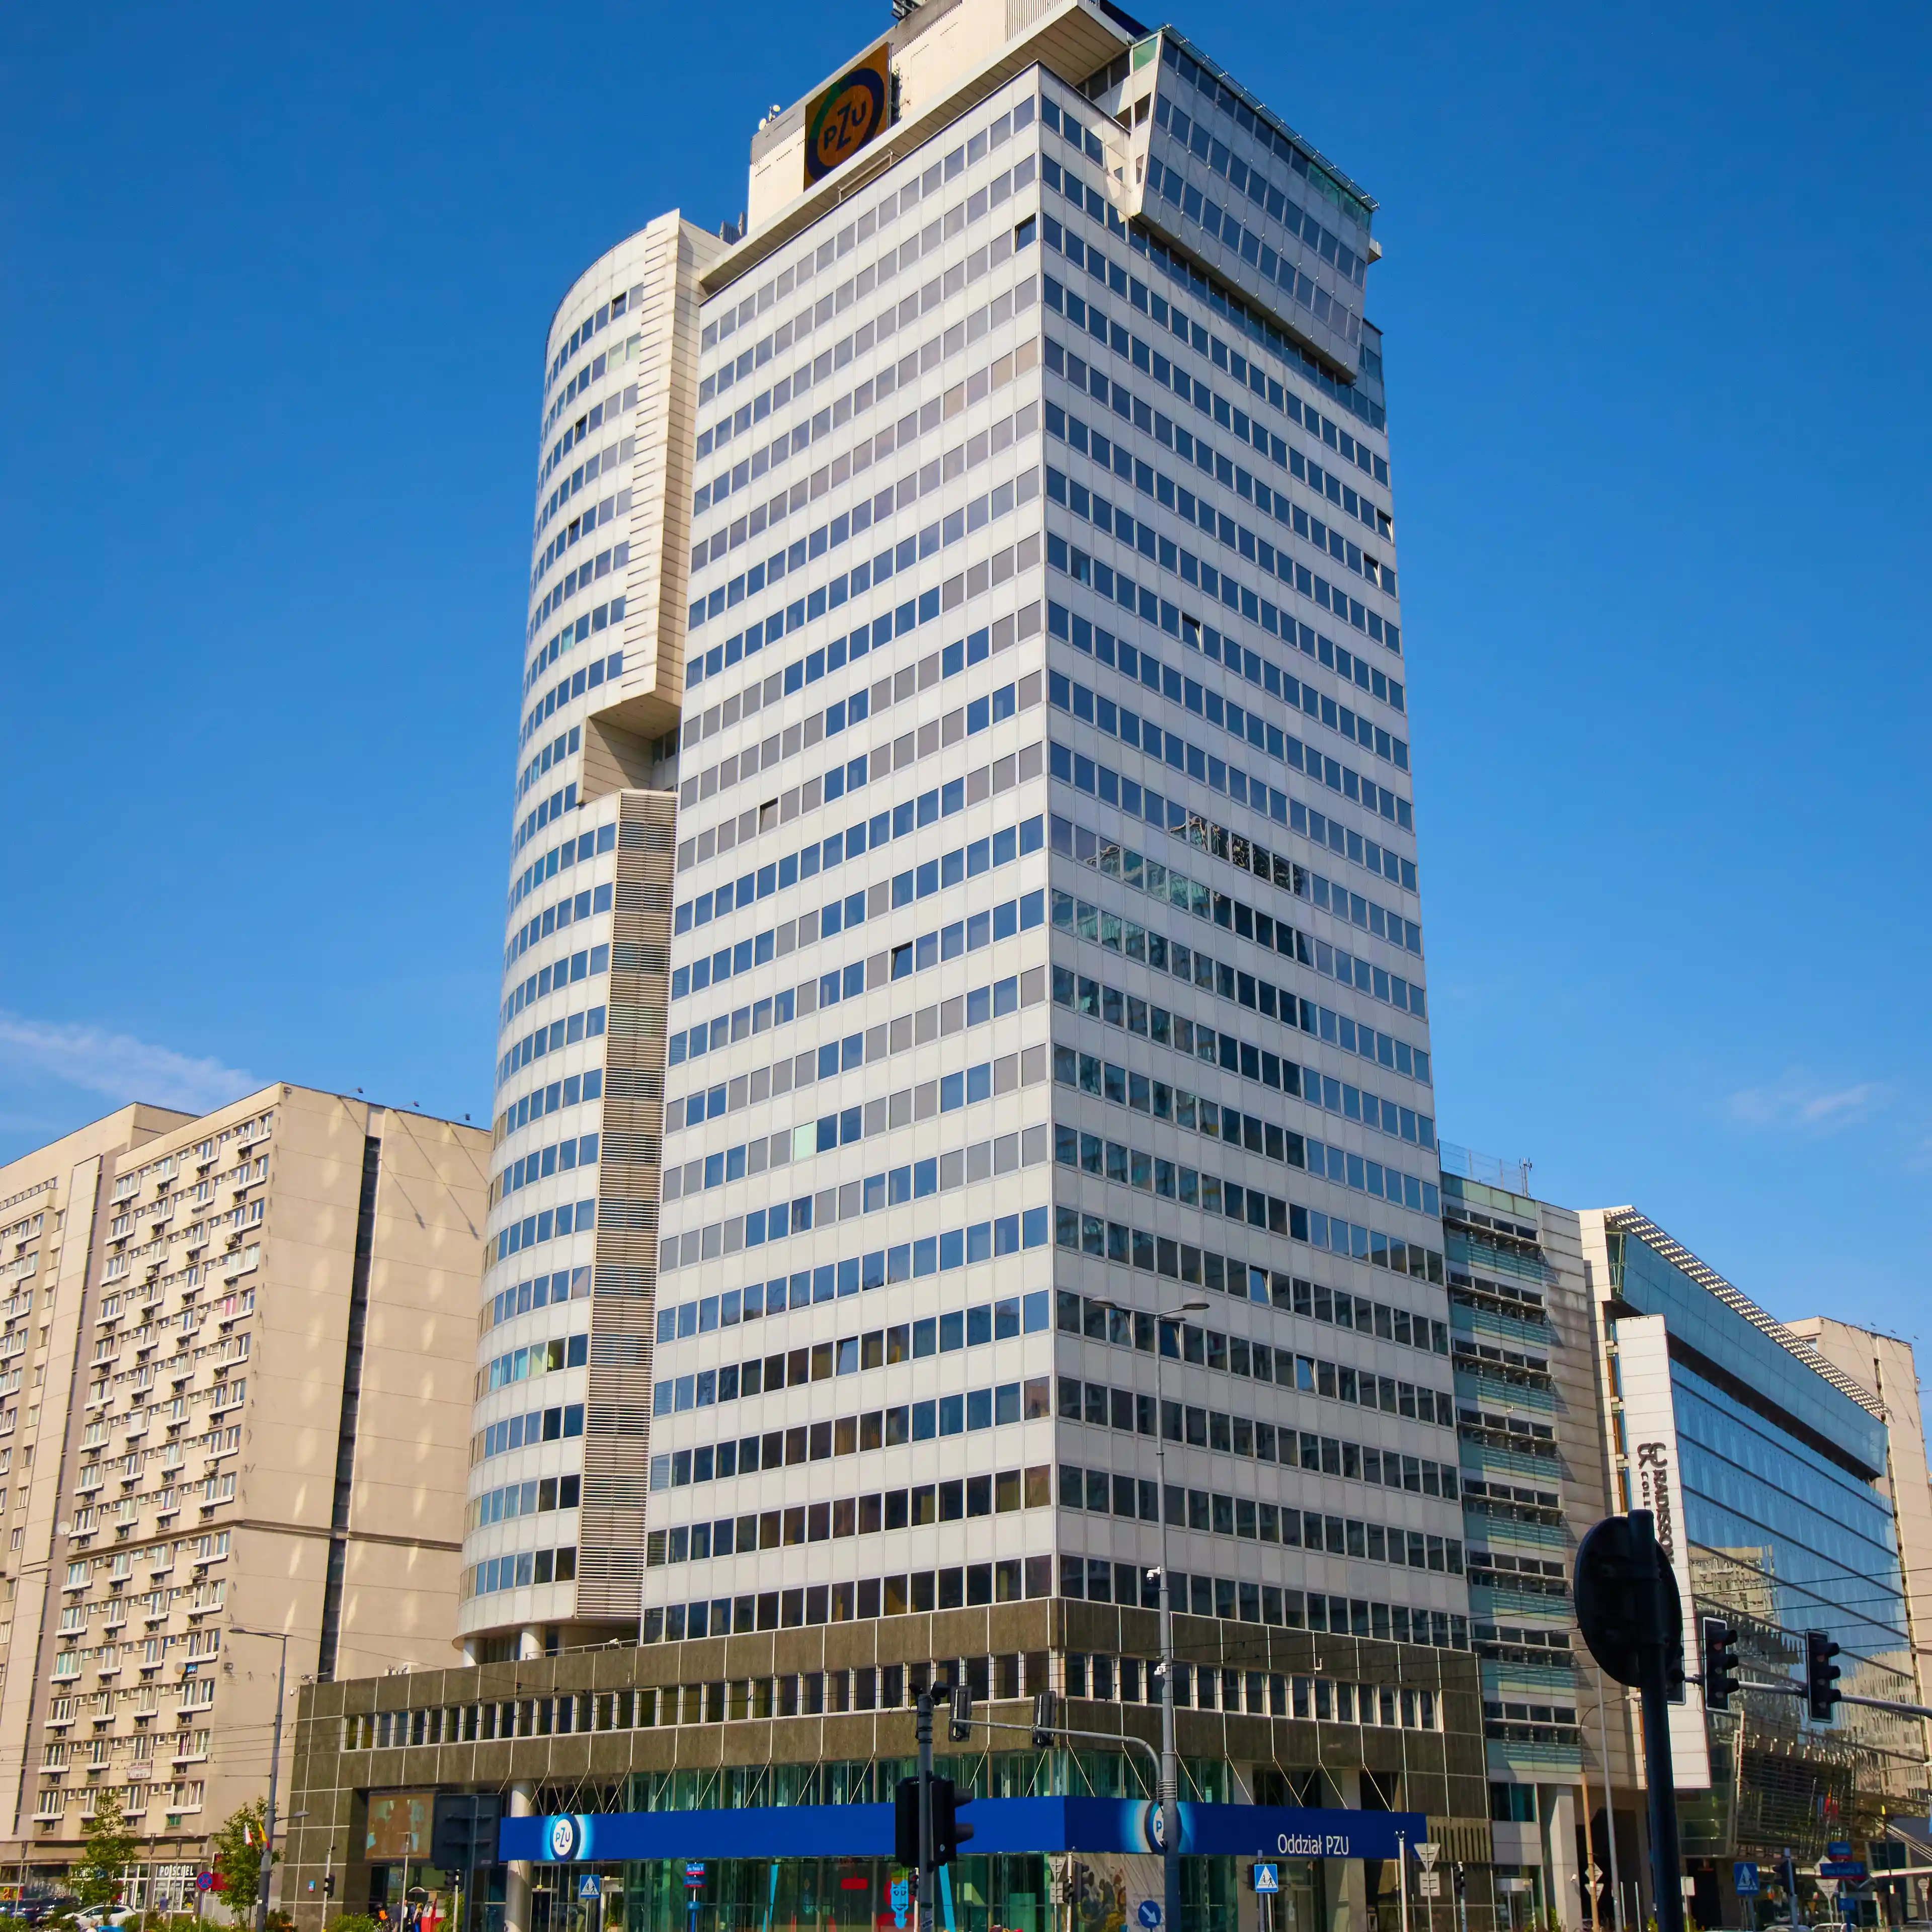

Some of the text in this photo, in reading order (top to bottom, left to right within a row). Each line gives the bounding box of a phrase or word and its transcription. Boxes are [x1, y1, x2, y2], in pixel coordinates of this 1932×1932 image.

[824, 101, 866, 151] PZU
[1641, 1471, 1651, 1509] COLL
[555, 1827, 570, 1847] PZU
[1277, 1833, 1349, 1855] Oddział PZU
